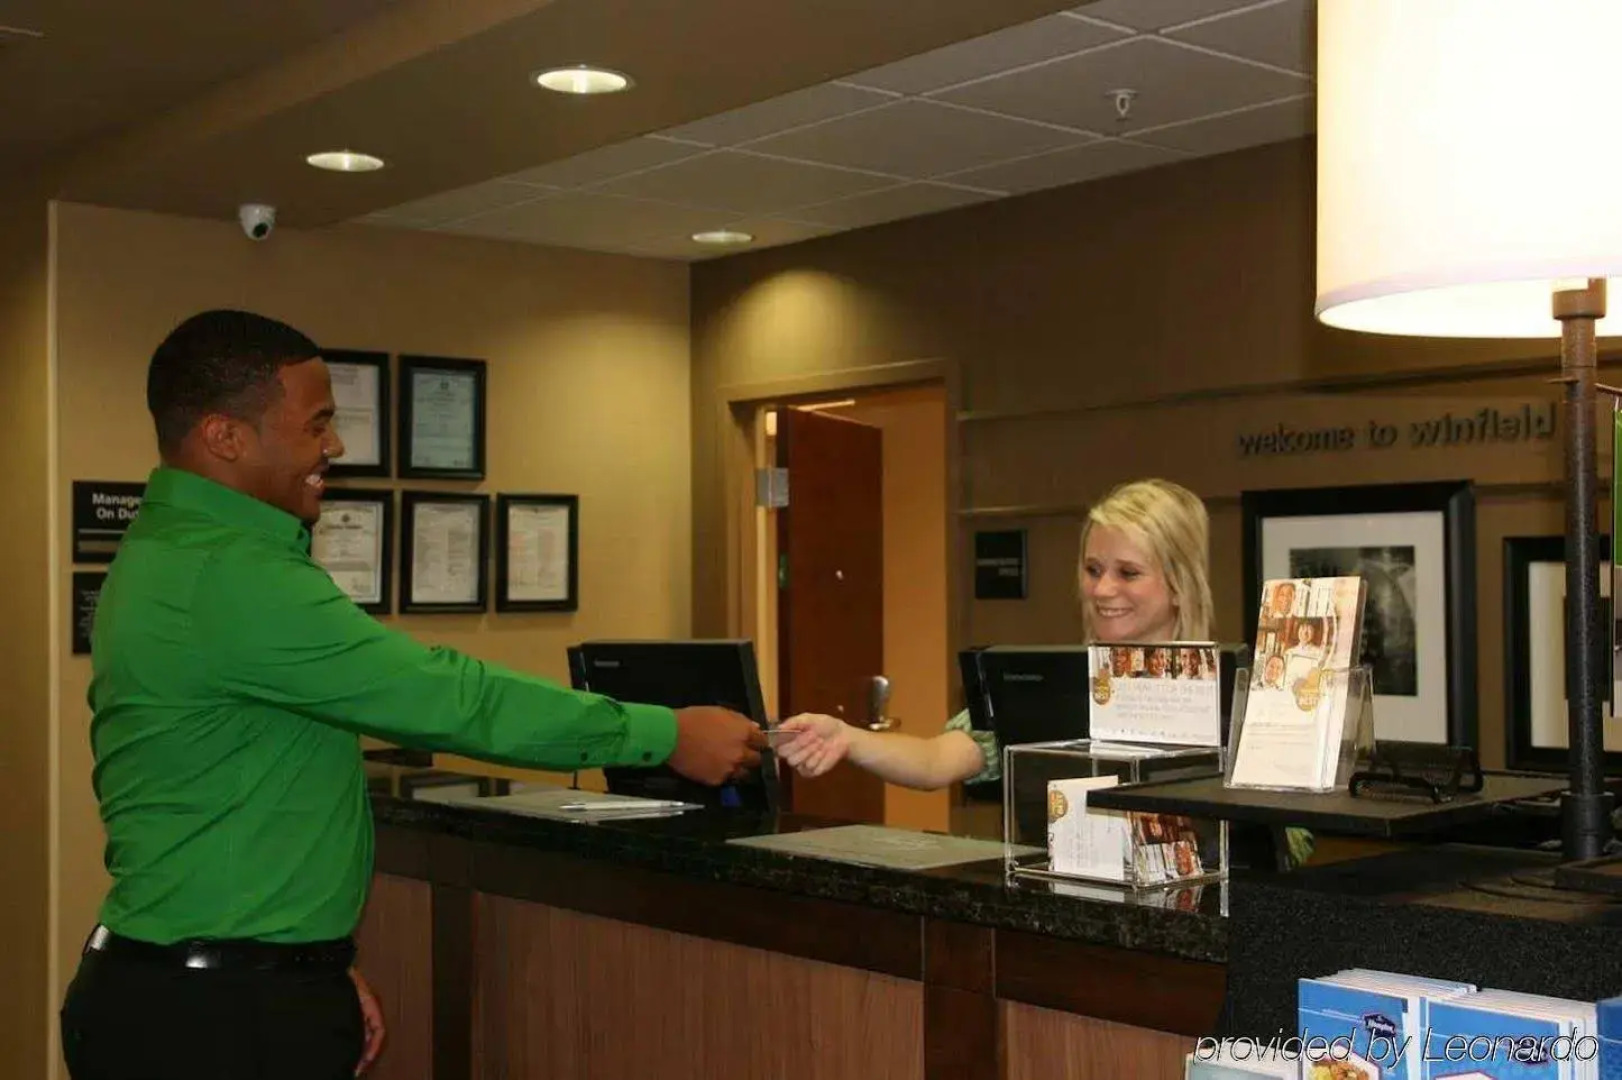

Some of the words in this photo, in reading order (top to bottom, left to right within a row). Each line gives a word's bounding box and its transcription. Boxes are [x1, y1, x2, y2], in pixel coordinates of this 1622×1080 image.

[1237, 421, 1355, 455] welcome
[1369, 419, 1399, 448] to
[1410, 402, 1557, 446] winfield
[92, 493, 143, 508] Manage
[96, 507, 115, 520] On
[118, 507, 139, 520] Du
